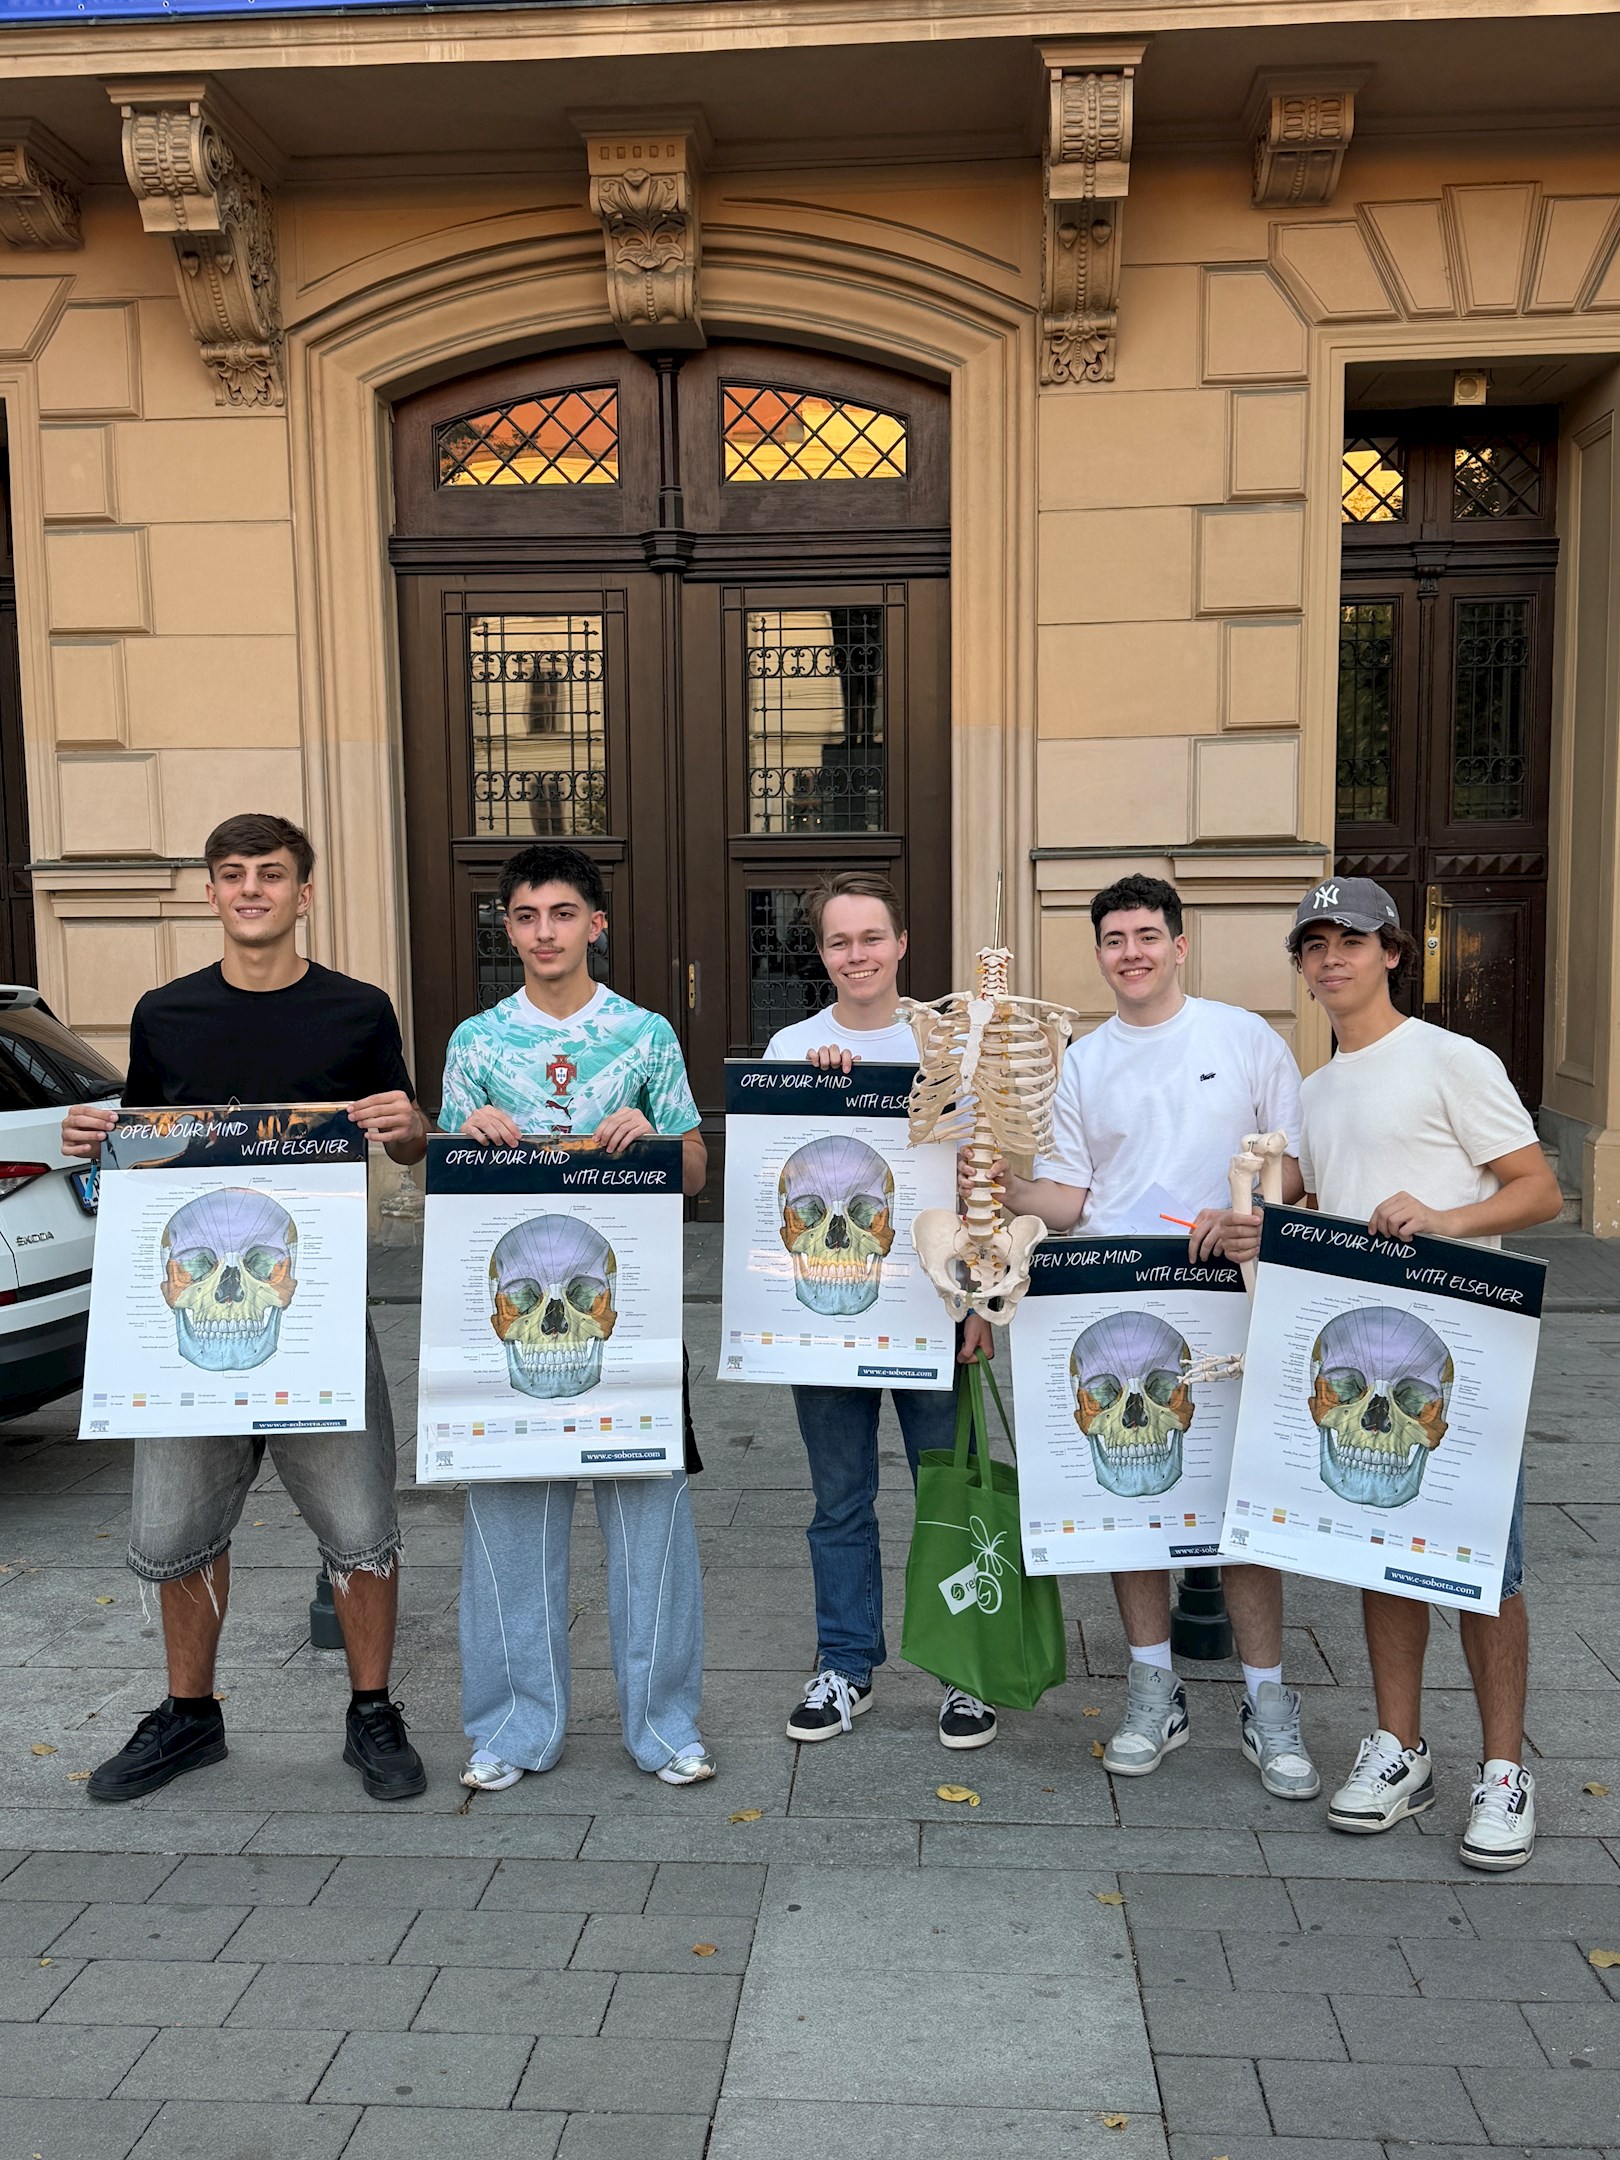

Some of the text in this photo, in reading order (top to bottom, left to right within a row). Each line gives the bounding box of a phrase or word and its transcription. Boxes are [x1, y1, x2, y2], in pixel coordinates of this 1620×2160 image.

[1312, 884, 1340, 909] NY
[740, 1074, 852, 1089] OPEN YOUR MIND
[845, 1093, 910, 1109] WITH ELSE
[120, 1121, 249, 1140] OPEN YOUR MIND
[241, 1138, 349, 1157] WITH ELSEVIER
[445, 1150, 571, 1165] OPEN YOUR MIND
[562, 1168, 667, 1185] WITH ELSEVIER
[1280, 1222, 1417, 1260] OPEN YOUR MIND
[1064, 1251, 1102, 1267] YOUR
[1103, 1250, 1143, 1265] MIND
[1135, 1266, 1238, 1283] WITH ELSEVIER
[1405, 1267, 1524, 1306] WITH ELSEVIER
[863, 1367, 933, 1377] www.e-sobotta.com
[587, 1450, 661, 1461] www.e-sobotta.com
[1174, 1546, 1218, 1555] www.e-sobo
[1391, 1570, 1475, 1595] www.e-sobotta.com
